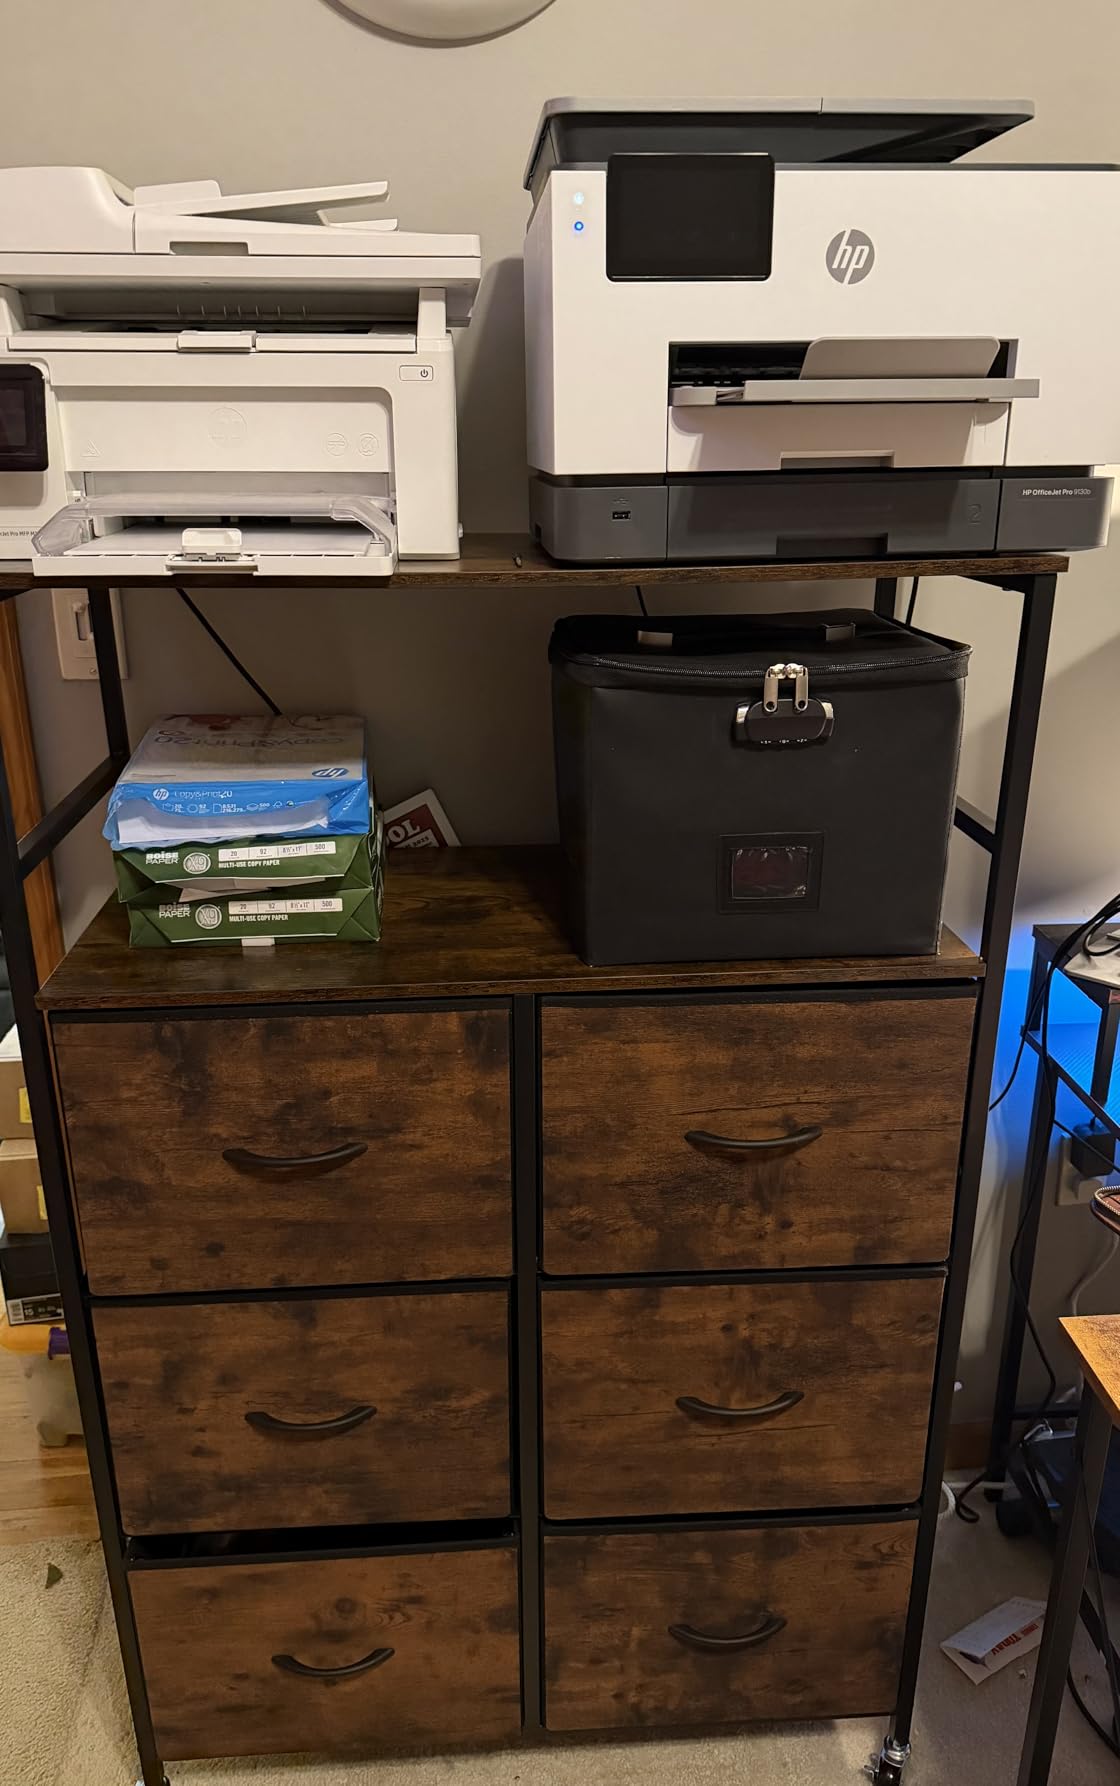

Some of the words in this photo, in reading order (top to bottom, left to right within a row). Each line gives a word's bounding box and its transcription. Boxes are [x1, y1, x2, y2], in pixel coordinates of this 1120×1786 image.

[827, 229, 875, 285] hp
[1032, 488, 1062, 496] OfficeJet
[1062, 488, 1073, 496] Pro
[153, 788, 170, 801] hp
[145, 857, 180, 865] PAPER
[218, 860, 247, 868] MULTI-USE
[159, 910, 190, 918] PAPER
